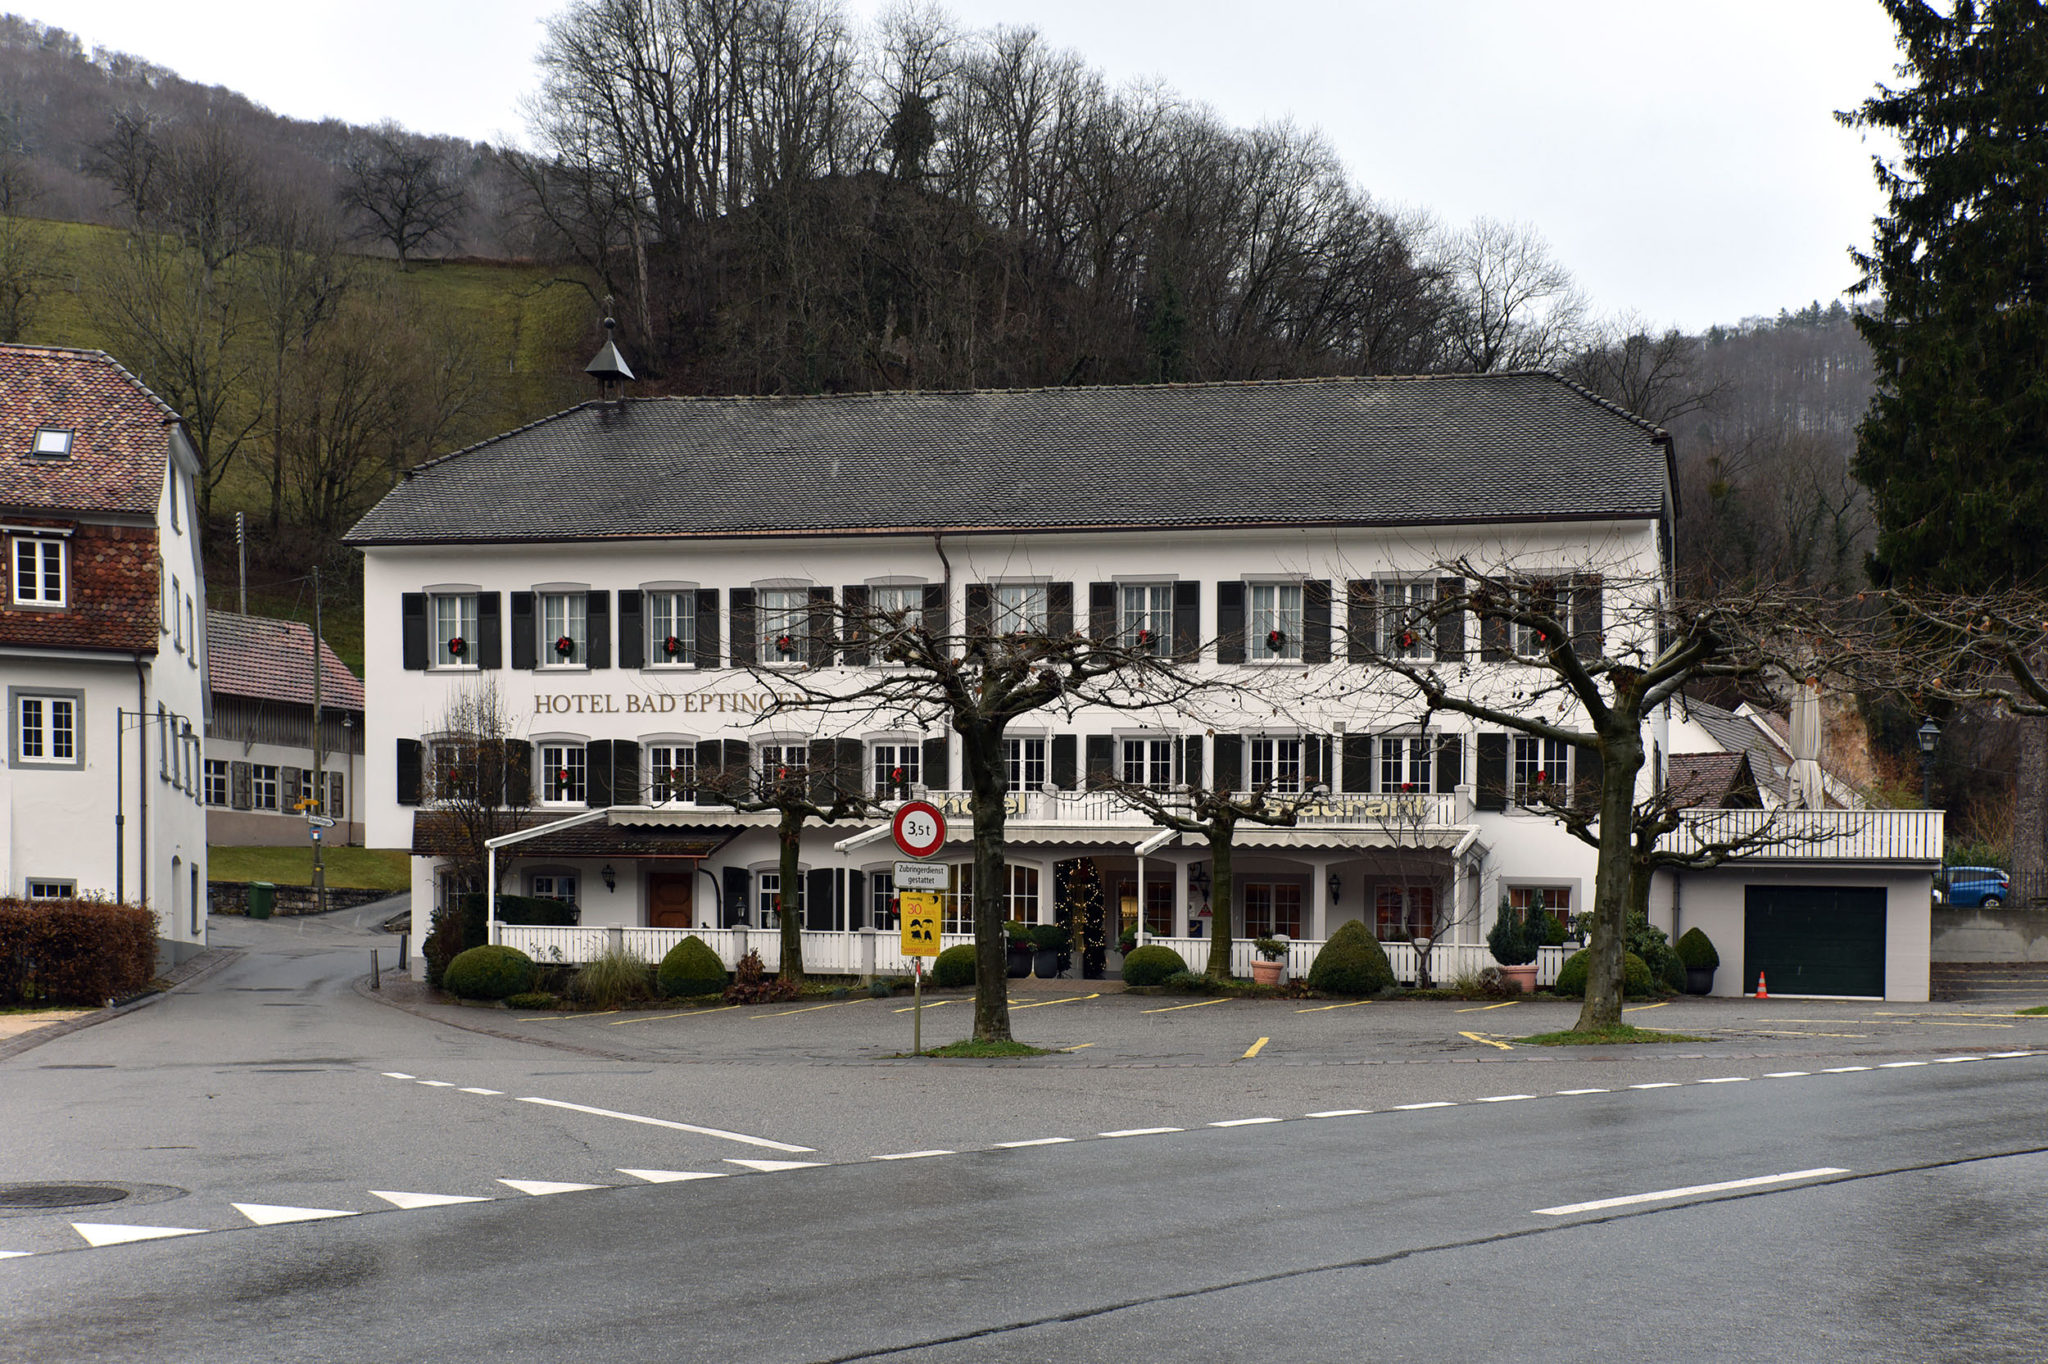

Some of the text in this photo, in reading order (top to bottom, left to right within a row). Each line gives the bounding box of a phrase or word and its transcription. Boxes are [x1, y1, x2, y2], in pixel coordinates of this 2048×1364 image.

[534, 694, 618, 713] HOTEL
[625, 694, 676, 713] BAD
[939, 793, 1025, 814] hoel
[908, 821, 924, 837] 3,5
[899, 865, 944, 875] Zubringerdienst
[907, 903, 923, 915] 30
